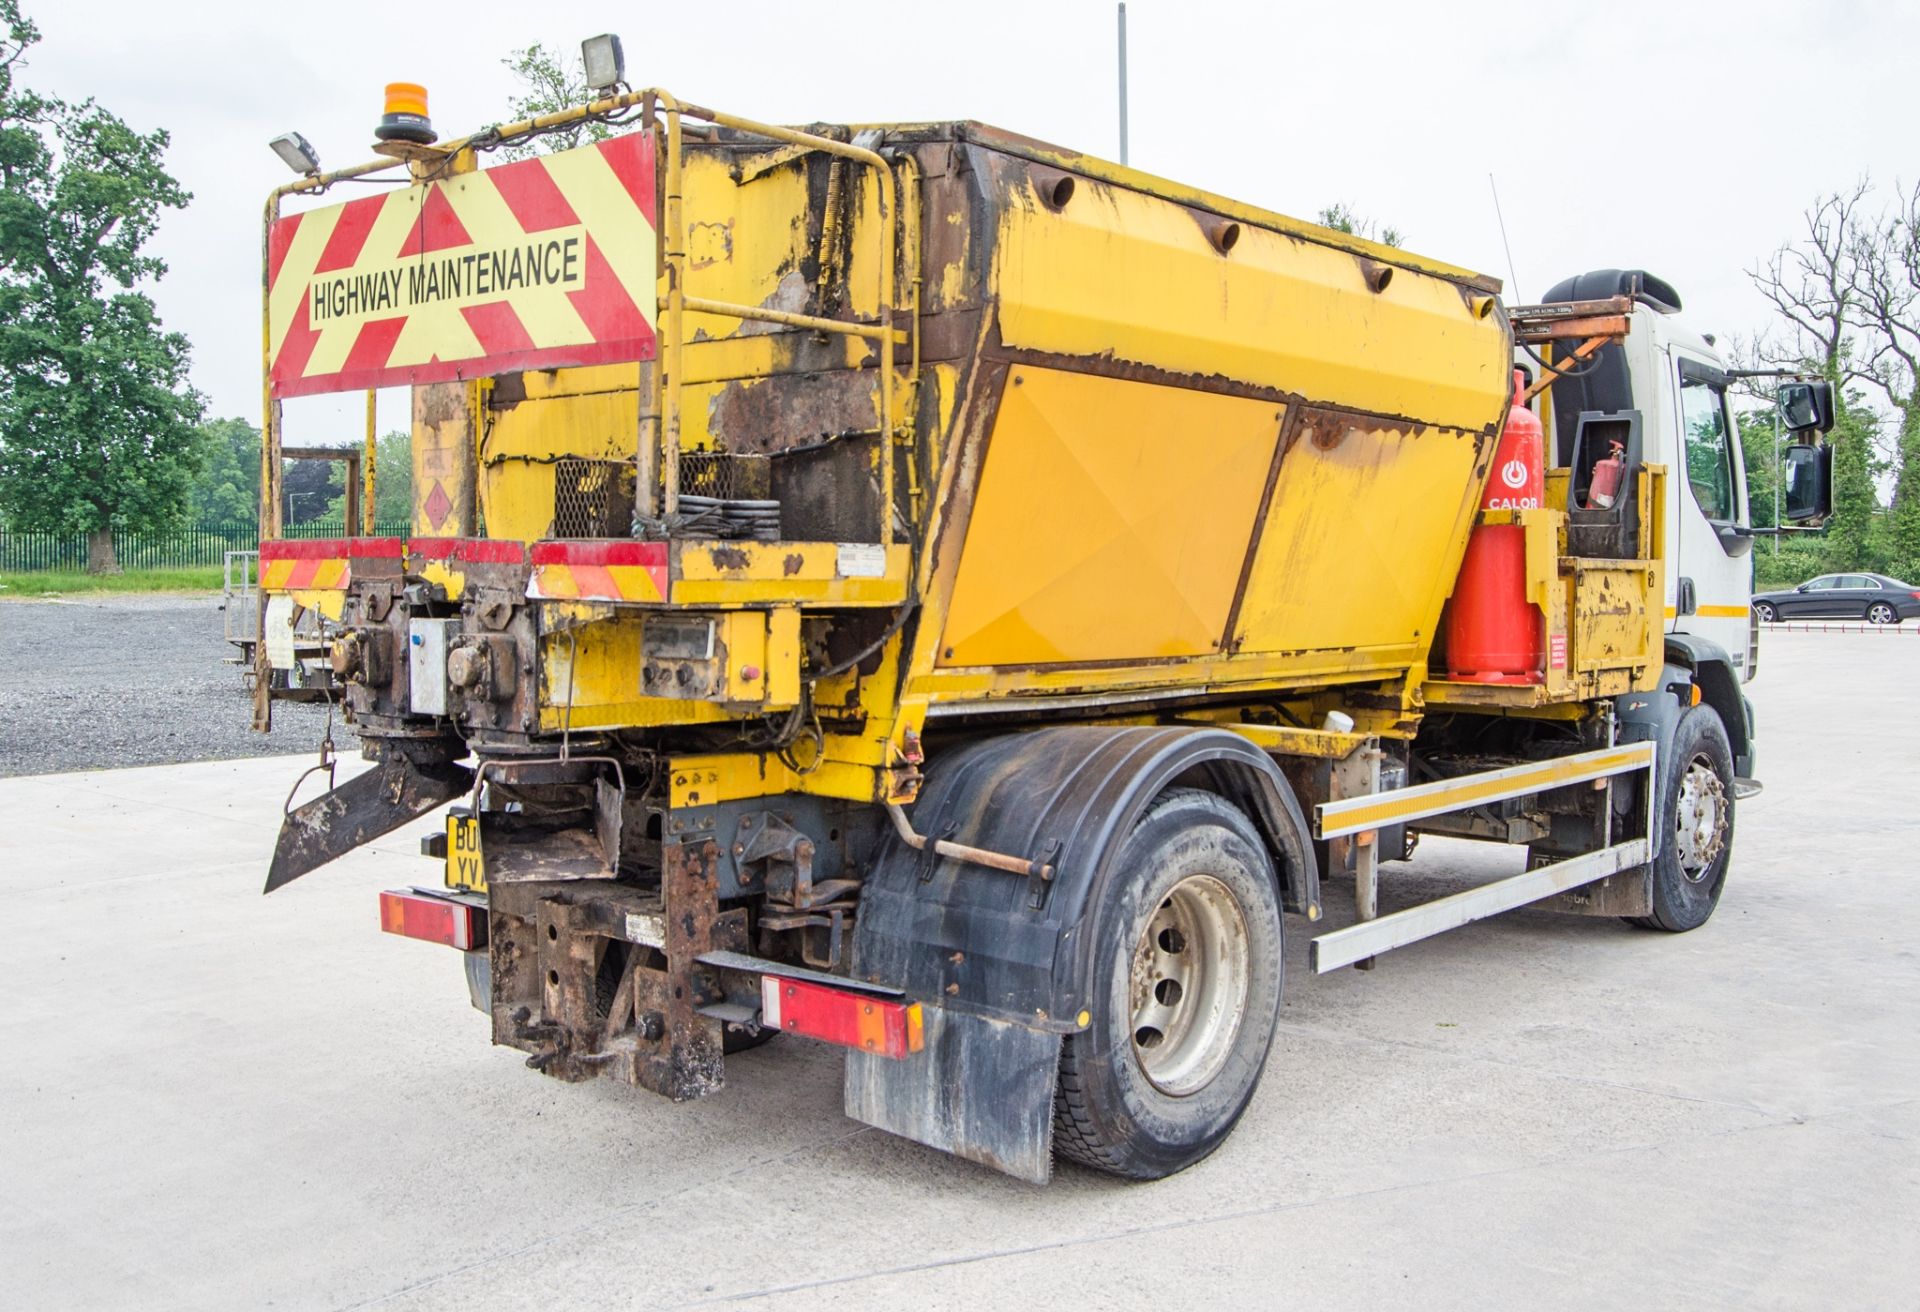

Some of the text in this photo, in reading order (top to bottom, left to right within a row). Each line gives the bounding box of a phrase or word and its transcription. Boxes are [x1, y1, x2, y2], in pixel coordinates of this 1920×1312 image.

[314, 237, 578, 321] HIGHWAY MAINTENANCE
[1489, 497, 1538, 510] CALOR
[456, 824, 482, 853] BU
